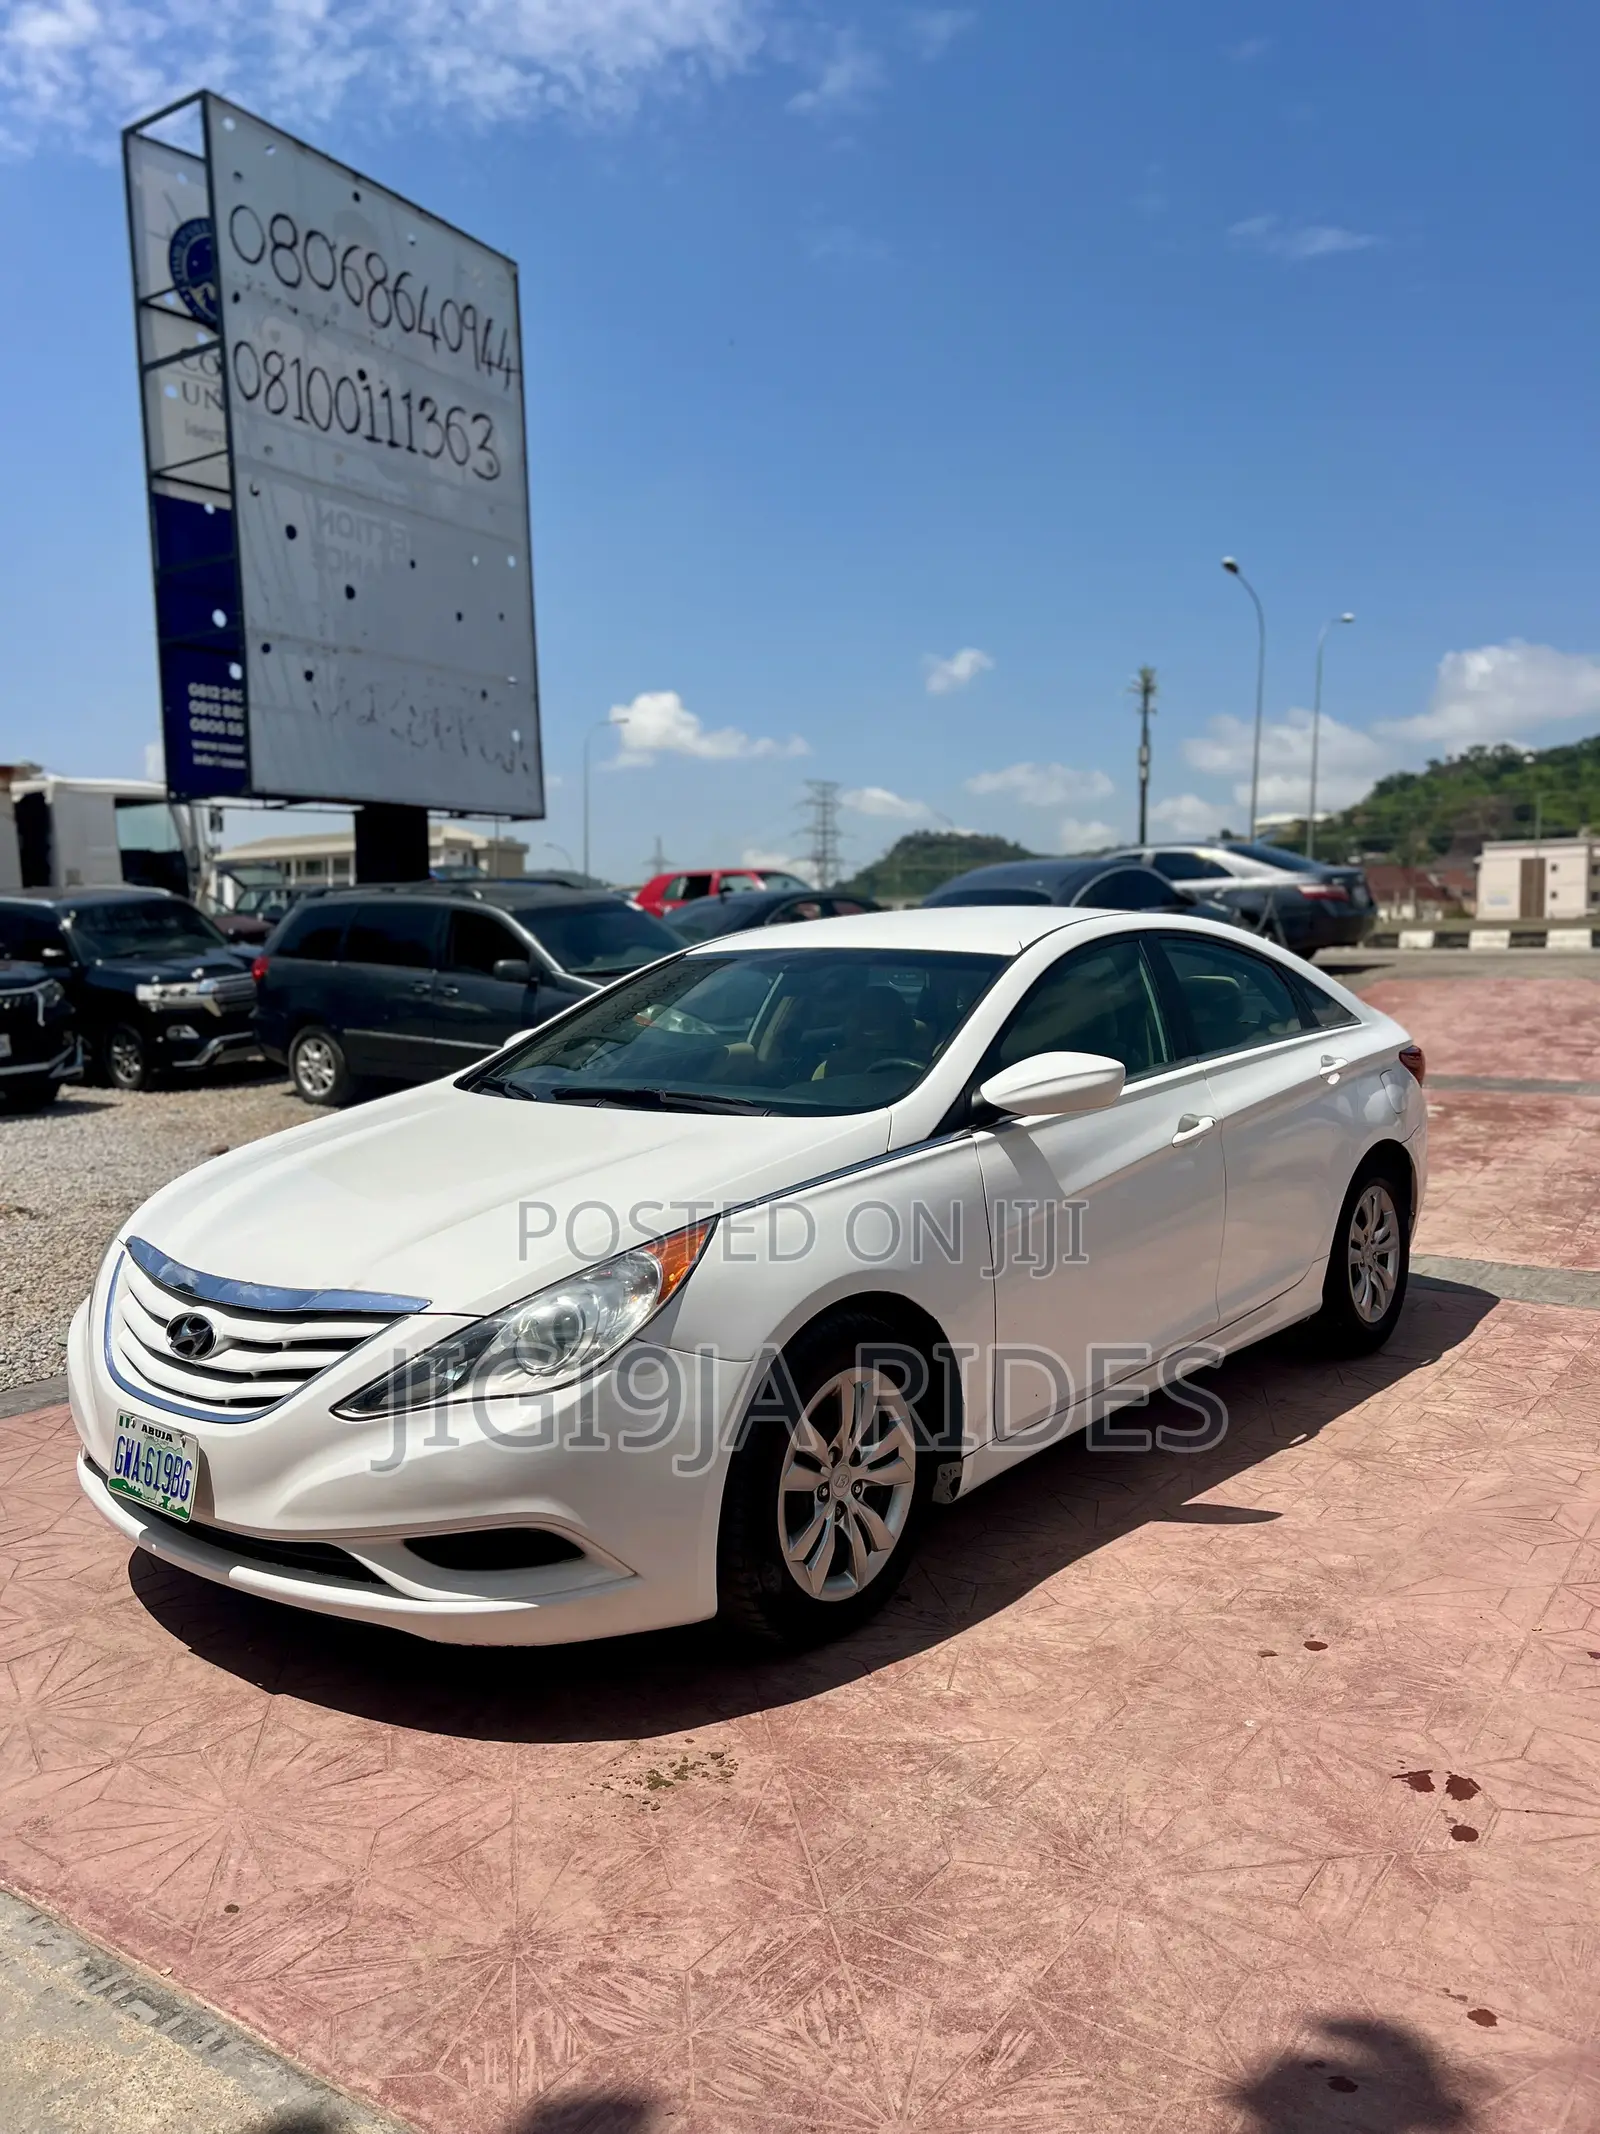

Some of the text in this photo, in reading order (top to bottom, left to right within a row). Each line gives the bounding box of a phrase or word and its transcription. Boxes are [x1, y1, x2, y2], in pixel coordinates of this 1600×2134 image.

[229, 204, 523, 392] 08068640944
[233, 340, 501, 481] 08100111363
[141, 1423, 173, 1443] ABUJA
